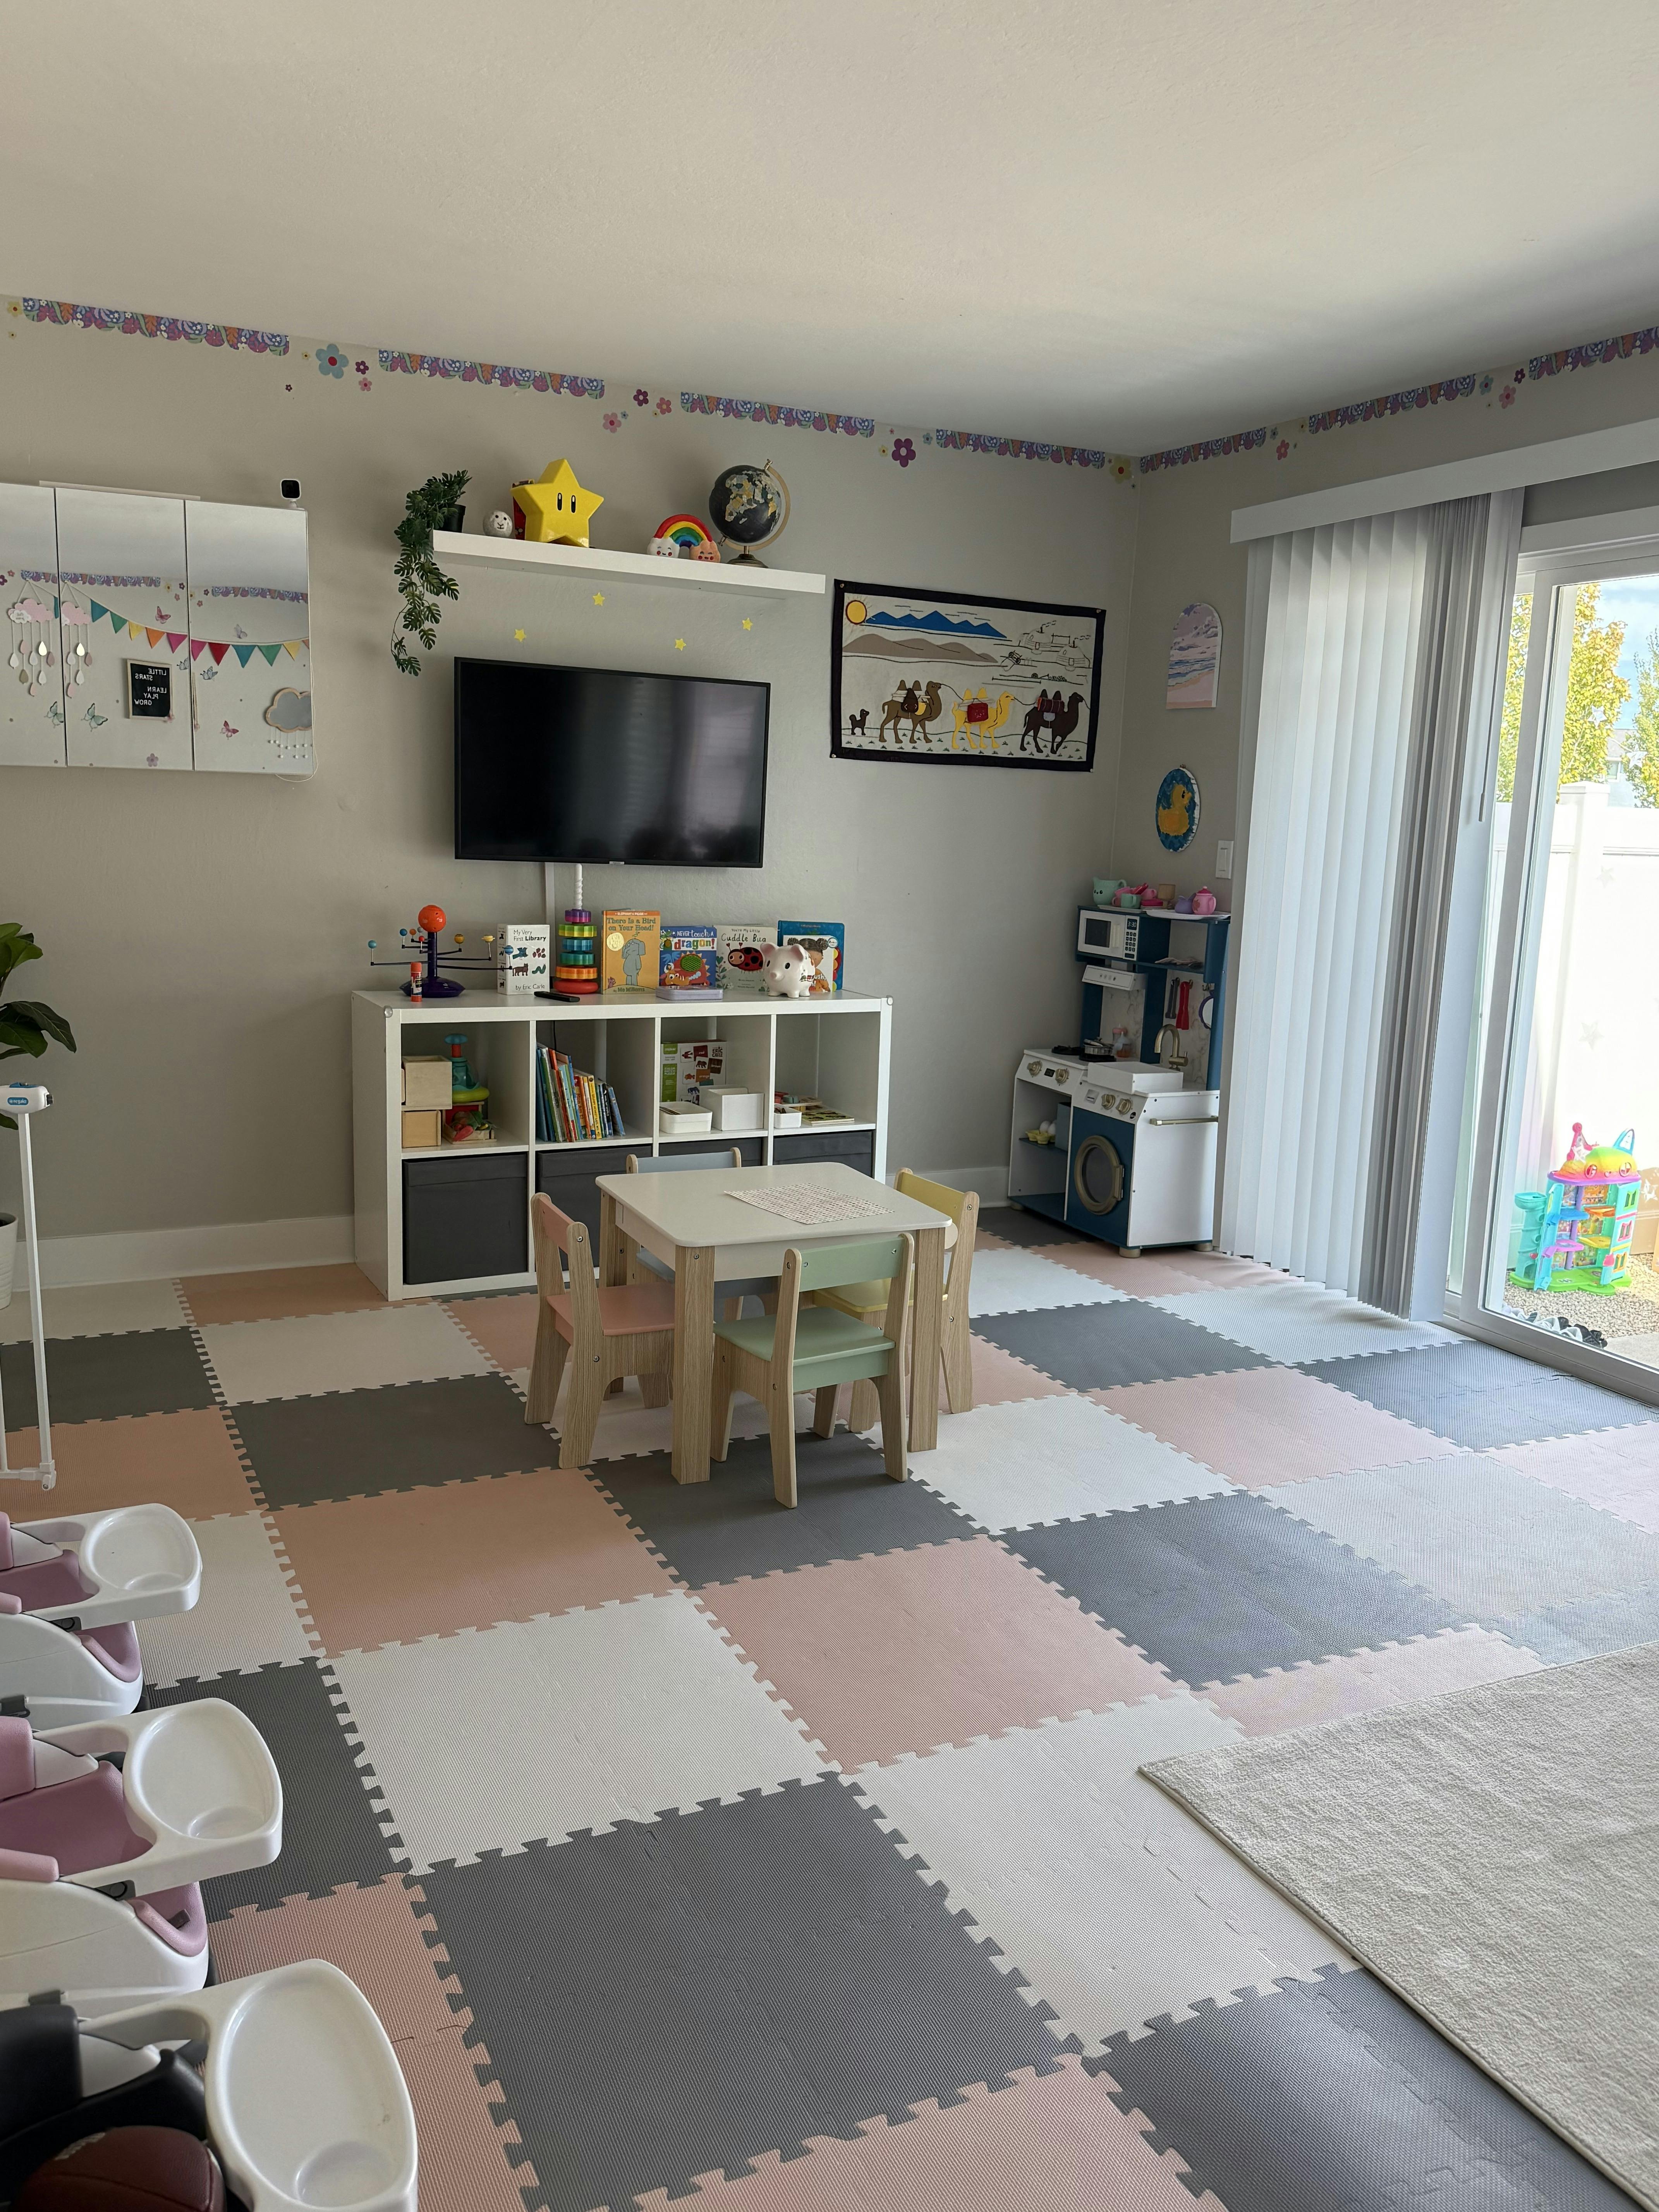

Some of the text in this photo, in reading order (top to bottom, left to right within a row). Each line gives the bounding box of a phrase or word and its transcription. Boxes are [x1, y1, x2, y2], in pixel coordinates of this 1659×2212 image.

[690, 929, 710, 937] touch
[721, 933, 748, 942] Cuddle
[674, 938, 715, 950] dragon!
